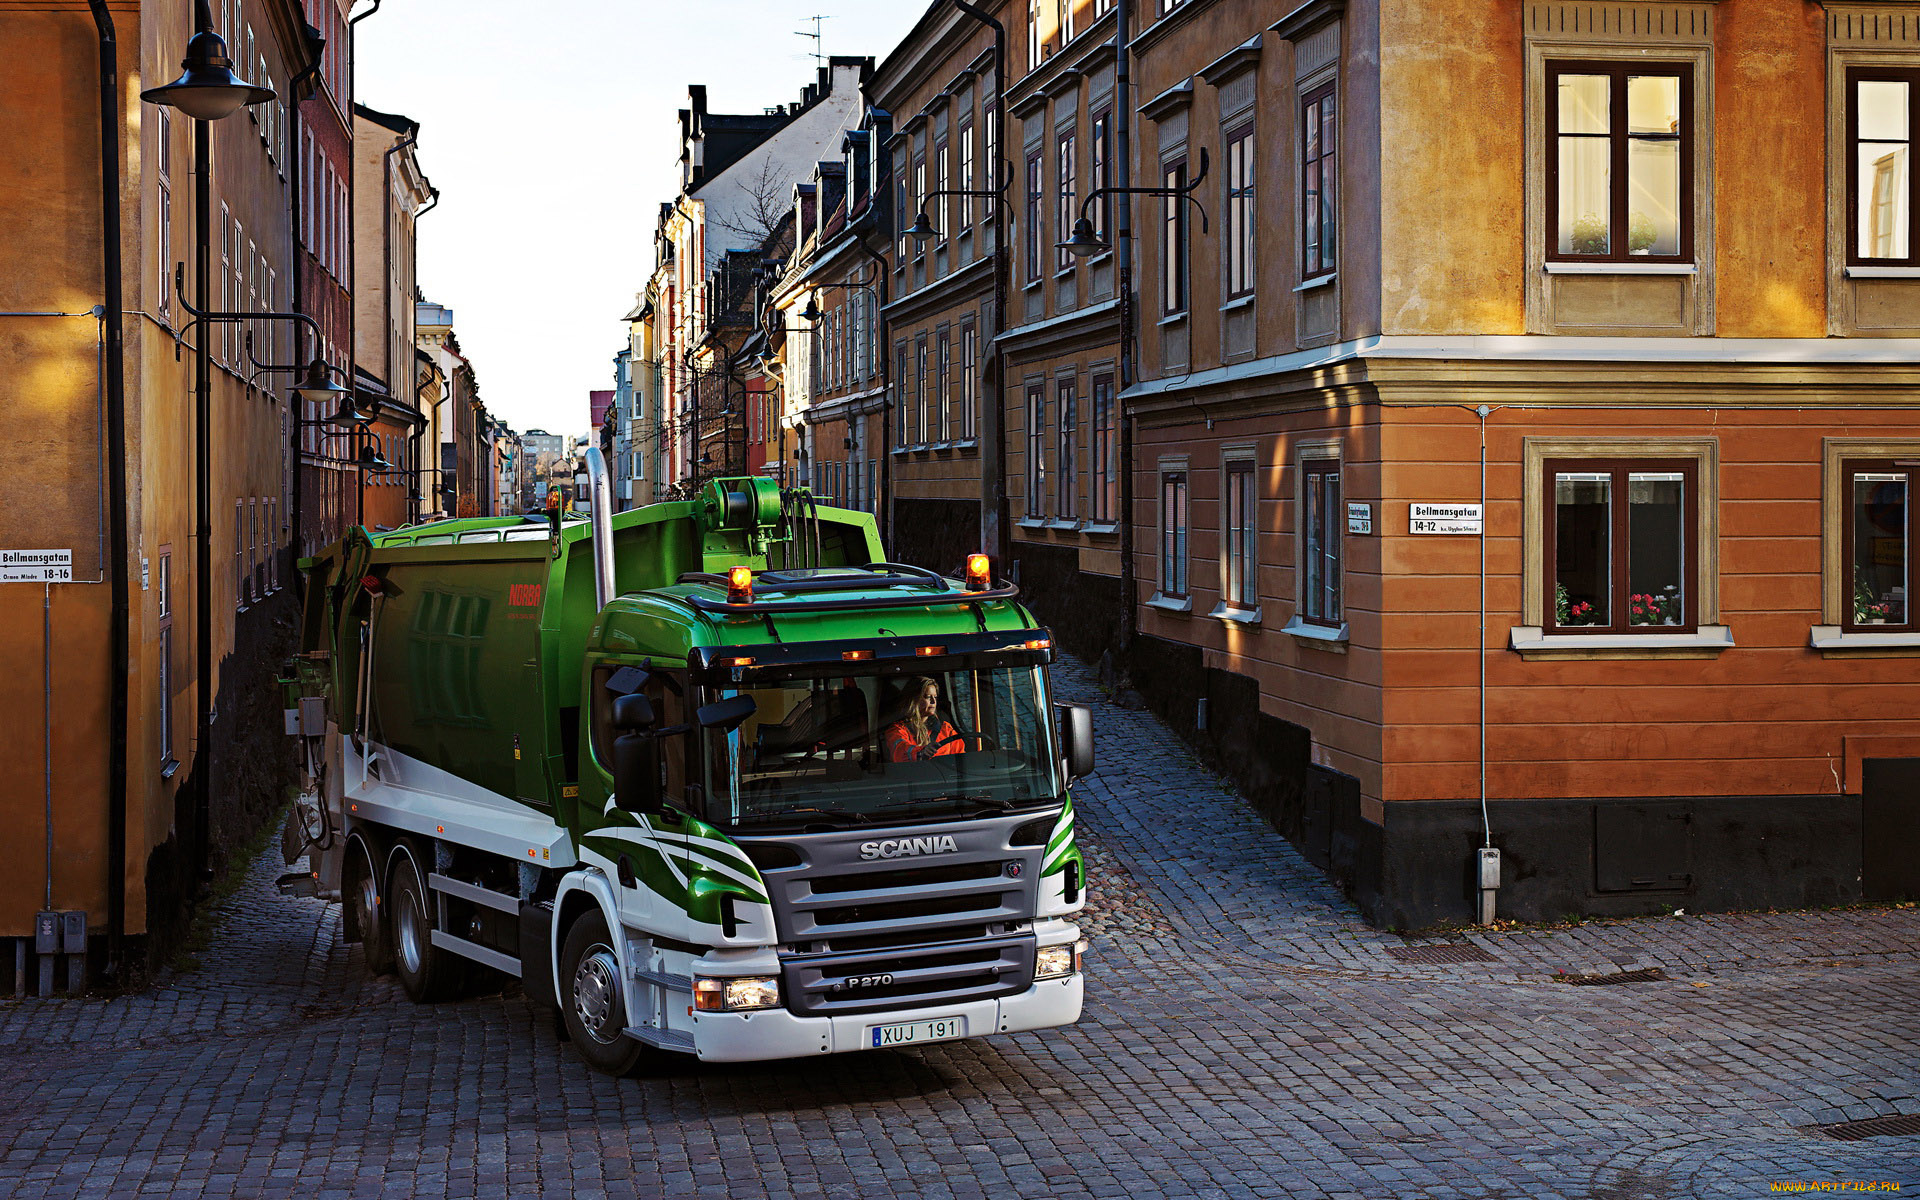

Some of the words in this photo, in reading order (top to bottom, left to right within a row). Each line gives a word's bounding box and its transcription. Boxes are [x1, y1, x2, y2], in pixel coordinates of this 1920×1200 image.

[1416, 506, 1477, 518] Bellmansgatan
[1415, 521, 1436, 531] 14-12
[3, 552, 69, 564] Bellmansgatan
[44, 569, 69, 579] 18-16
[508, 584, 541, 607] NORBA
[860, 835, 958, 860] SCANIA
[848, 977, 859, 989] P
[861, 974, 892, 988] 270
[883, 1025, 914, 1044] XUJ
[928, 1020, 954, 1038] 191
